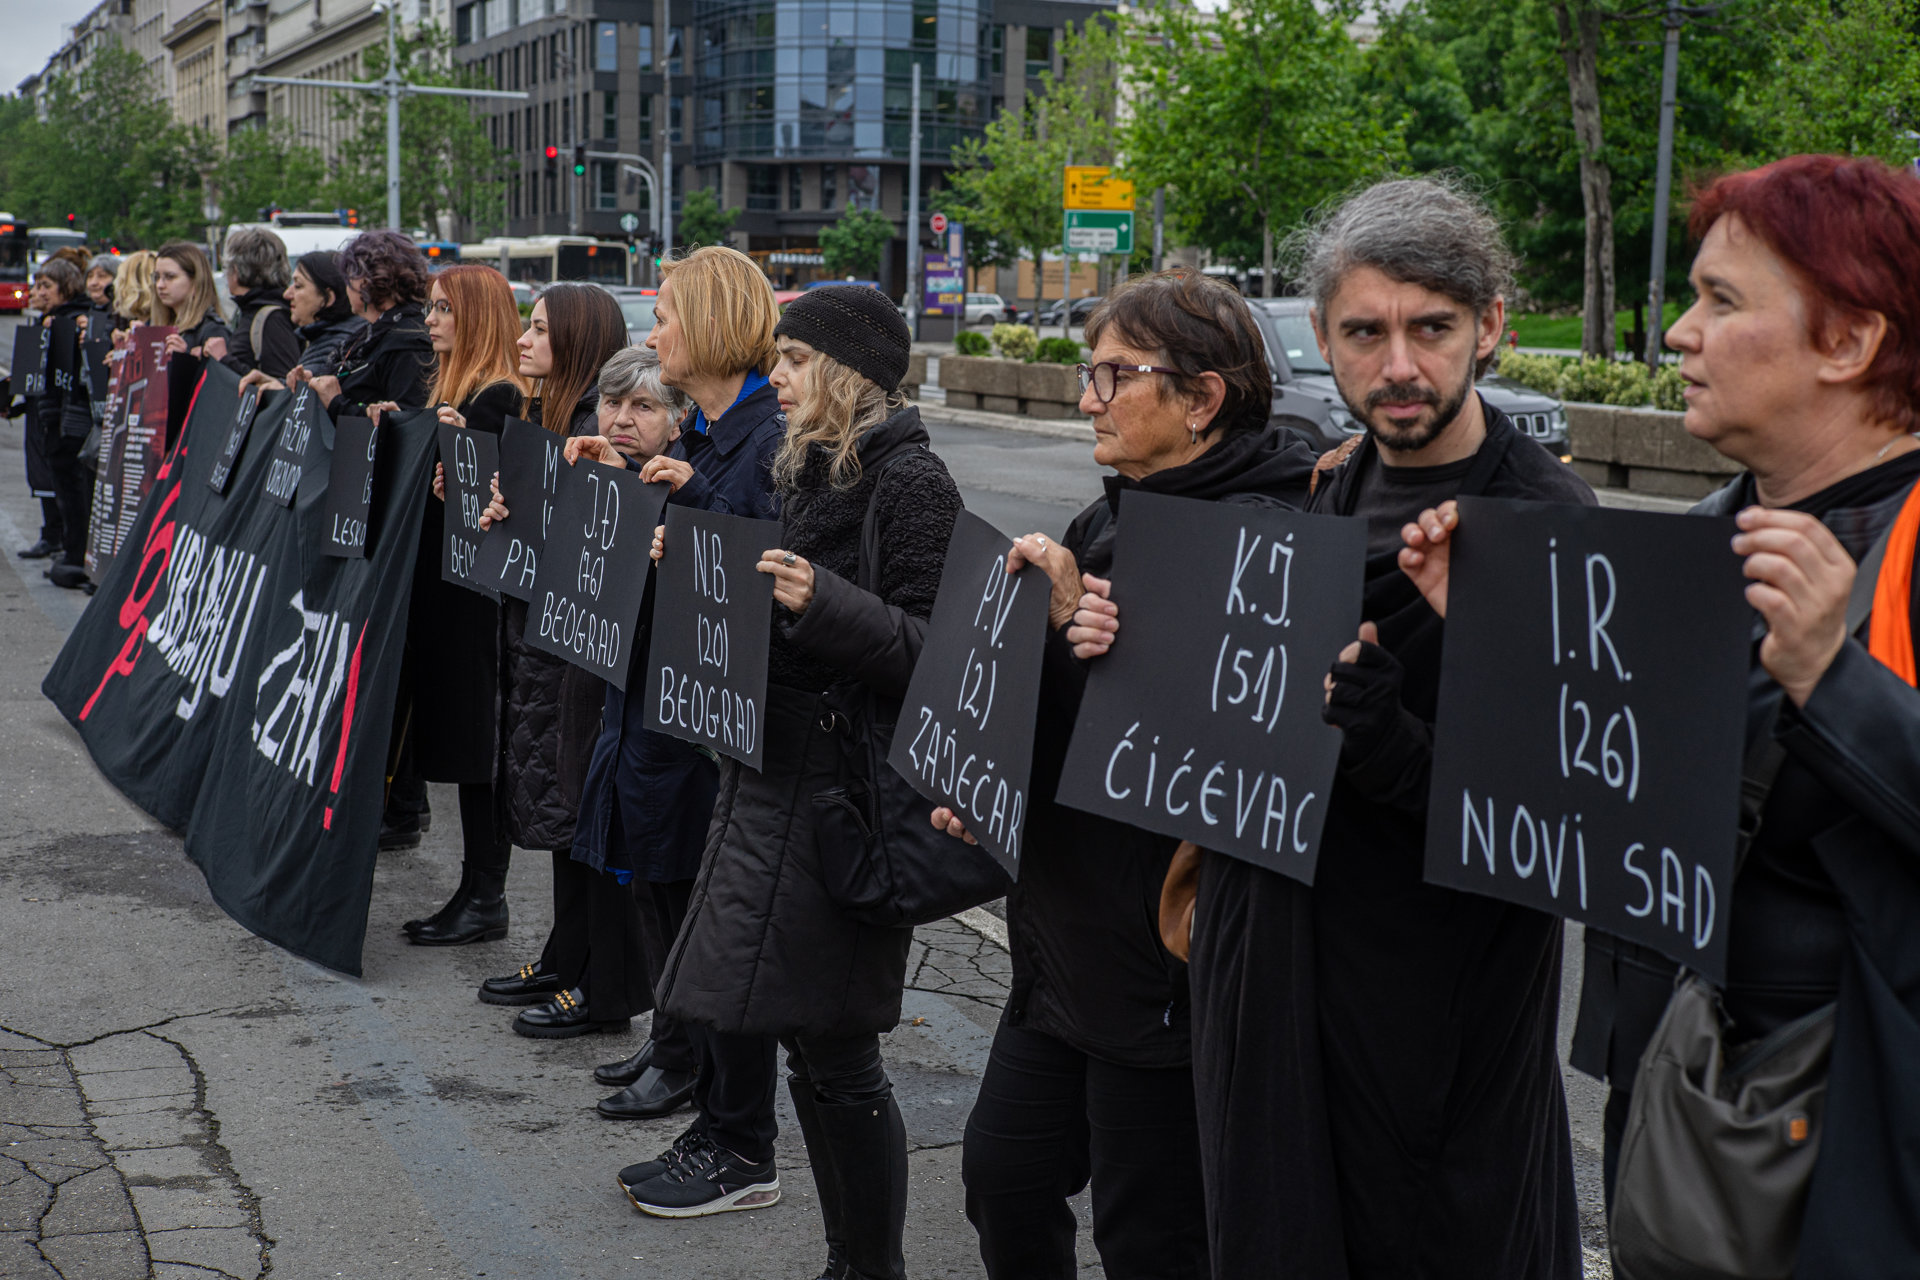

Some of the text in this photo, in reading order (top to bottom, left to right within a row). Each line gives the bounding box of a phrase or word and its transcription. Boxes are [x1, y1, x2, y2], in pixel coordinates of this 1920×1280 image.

[578, 546, 604, 601] (76)
[693, 526, 729, 604] N.B.
[974, 554, 1022, 649] P.V.
[1226, 526, 1294, 628] K.J.
[540, 591, 620, 668] BEOGRAD
[698, 613, 728, 677] (20)
[659, 666, 756, 754] BEOGRAD
[958, 647, 996, 731] (2)
[1211, 634, 1289, 734] (51)
[908, 706, 1023, 860] ZAJEČAR
[1559, 683, 1640, 803] (26)
[1623, 842, 1716, 950] SAD
